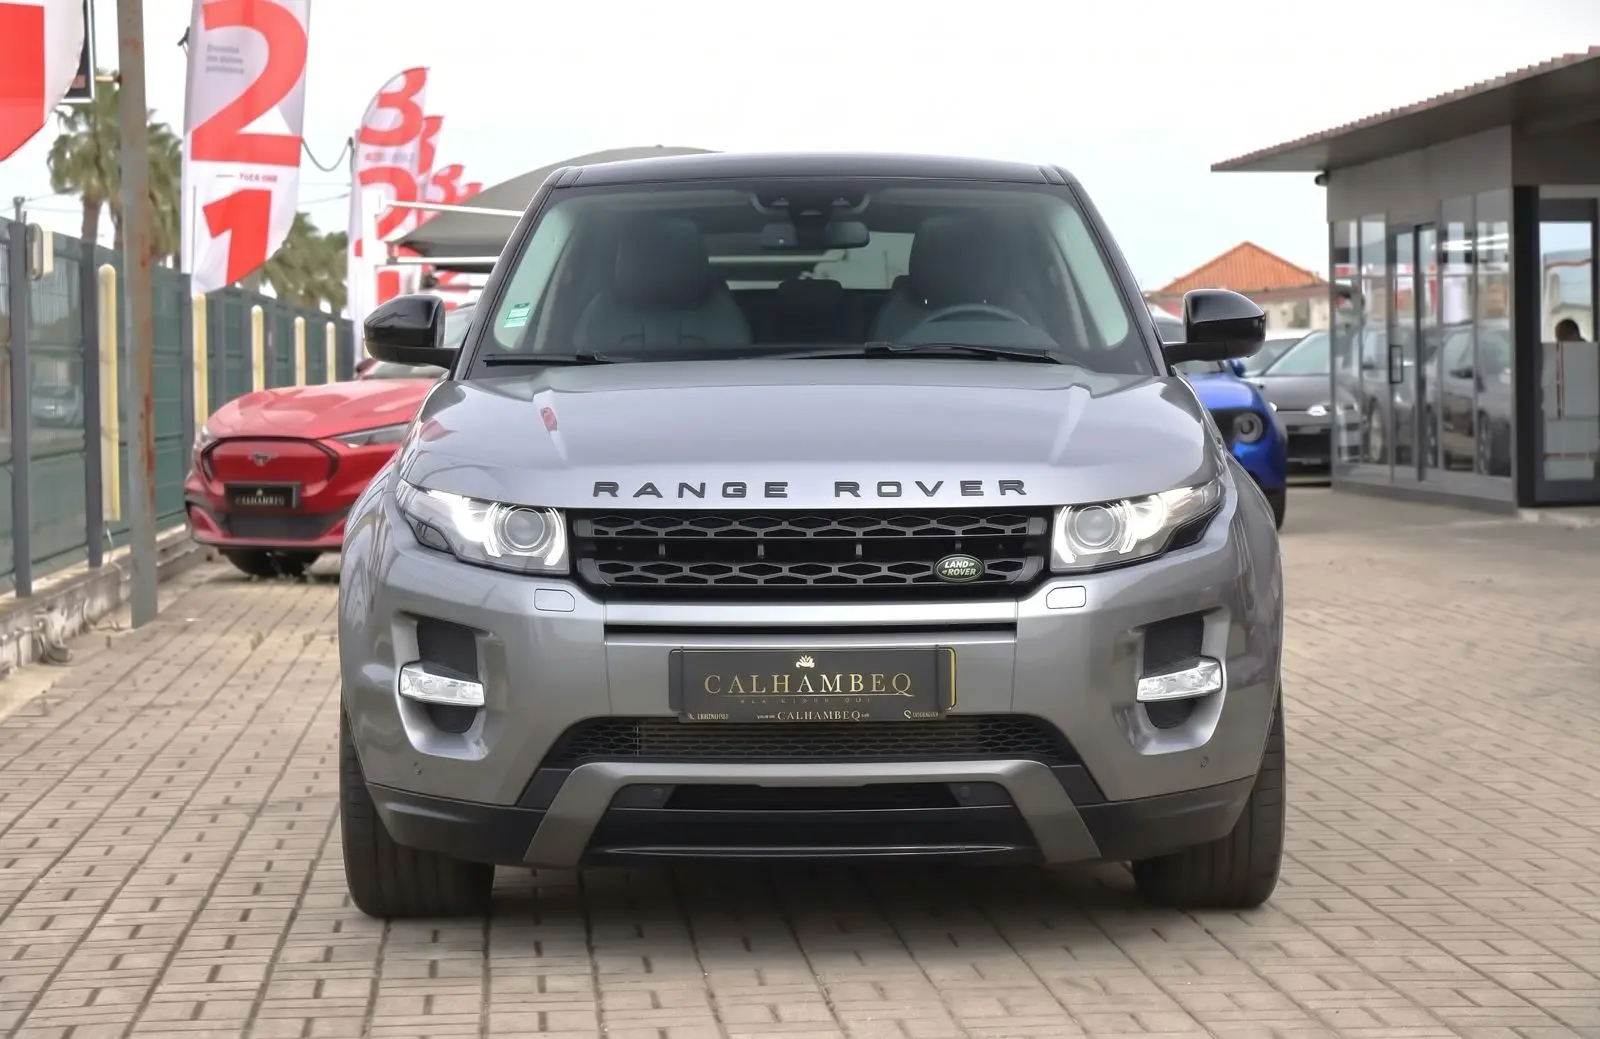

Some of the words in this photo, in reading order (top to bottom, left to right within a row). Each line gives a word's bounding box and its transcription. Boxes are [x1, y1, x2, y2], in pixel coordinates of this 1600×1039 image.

[191, 0, 307, 167] 2
[359, 66, 427, 147] 3
[202, 188, 272, 285] 1
[593, 481, 788, 499] RANGE
[834, 479, 1028, 498] ROVER
[944, 560, 969, 569] LAND
[947, 568, 977, 576] ROVER
[704, 672, 915, 697] CALHAMBEQ
[777, 710, 861, 722] CALHAMBEQ
